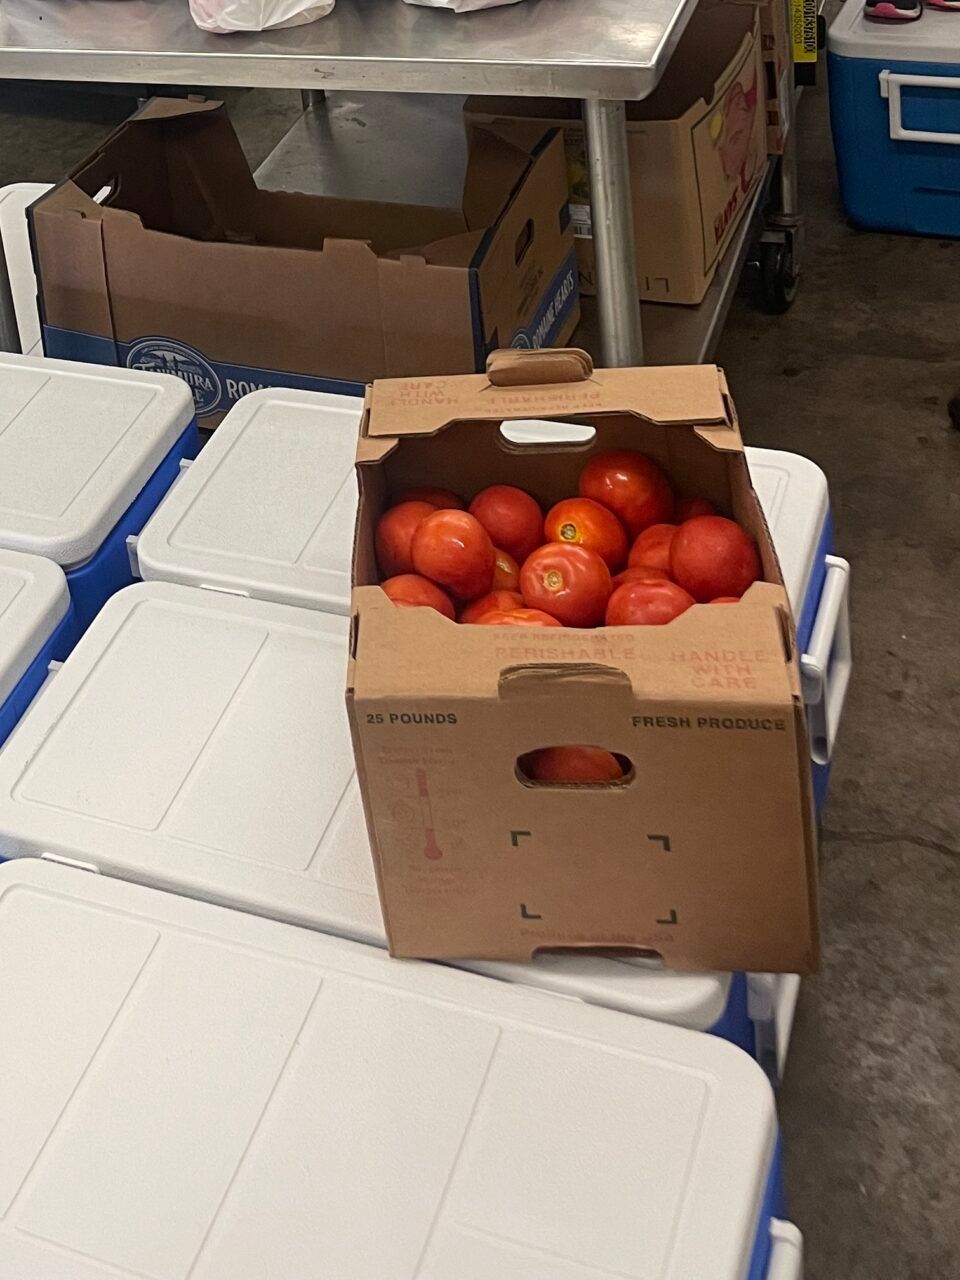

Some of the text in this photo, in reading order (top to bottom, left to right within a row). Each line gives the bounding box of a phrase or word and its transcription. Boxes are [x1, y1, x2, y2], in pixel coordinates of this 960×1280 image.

[495, 647, 636, 661] PERISHABLE
[671, 650, 768, 662] HANDLE
[694, 664, 752, 676] WITH
[691, 677, 756, 689] CARE
[366, 713, 458, 724] 25 POUNDS
[632, 716, 785, 731] FRESH PRODUCE
